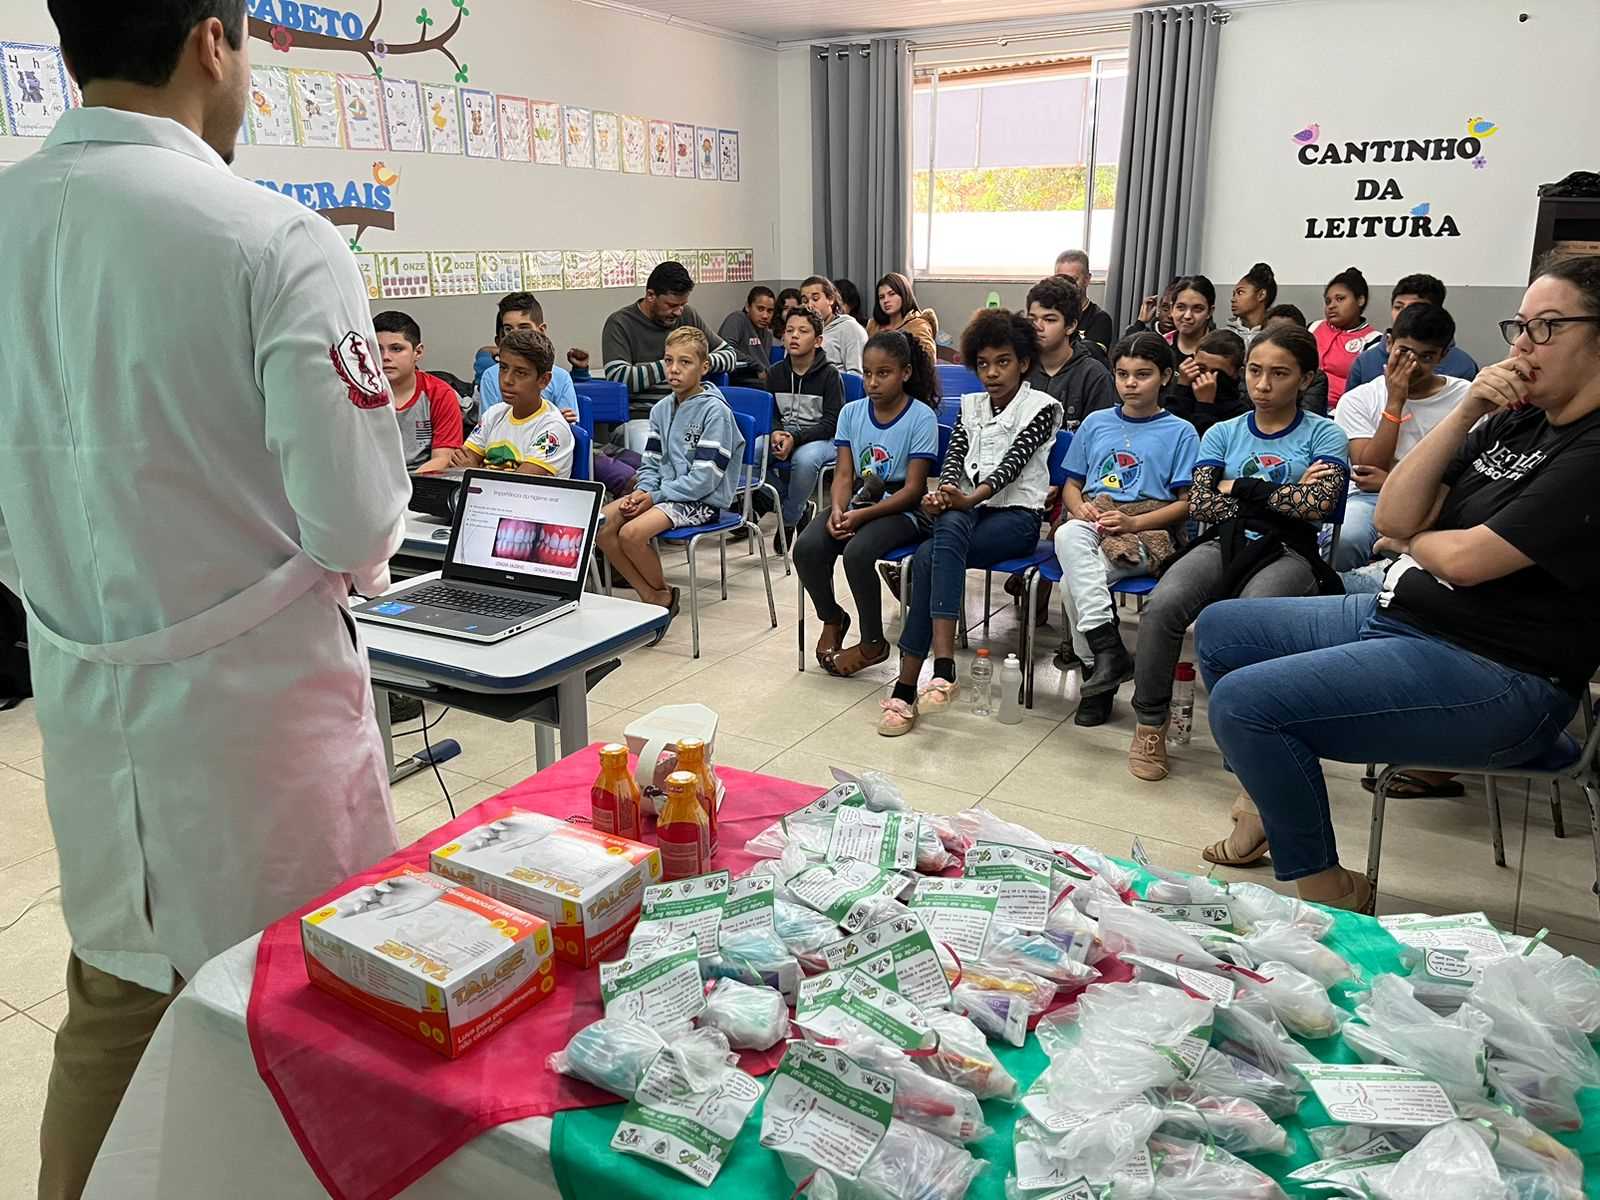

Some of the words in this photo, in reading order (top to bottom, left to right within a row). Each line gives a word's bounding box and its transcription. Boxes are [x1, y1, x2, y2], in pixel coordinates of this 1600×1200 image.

[1298, 137, 1481, 165] CANTINHO
[1354, 178, 1404, 201] DA
[1304, 215, 1461, 239] LEITURA
[382, 256, 400, 275] 11
[728, 253, 739, 266] 20
[451, 949, 527, 1007] TALGE
